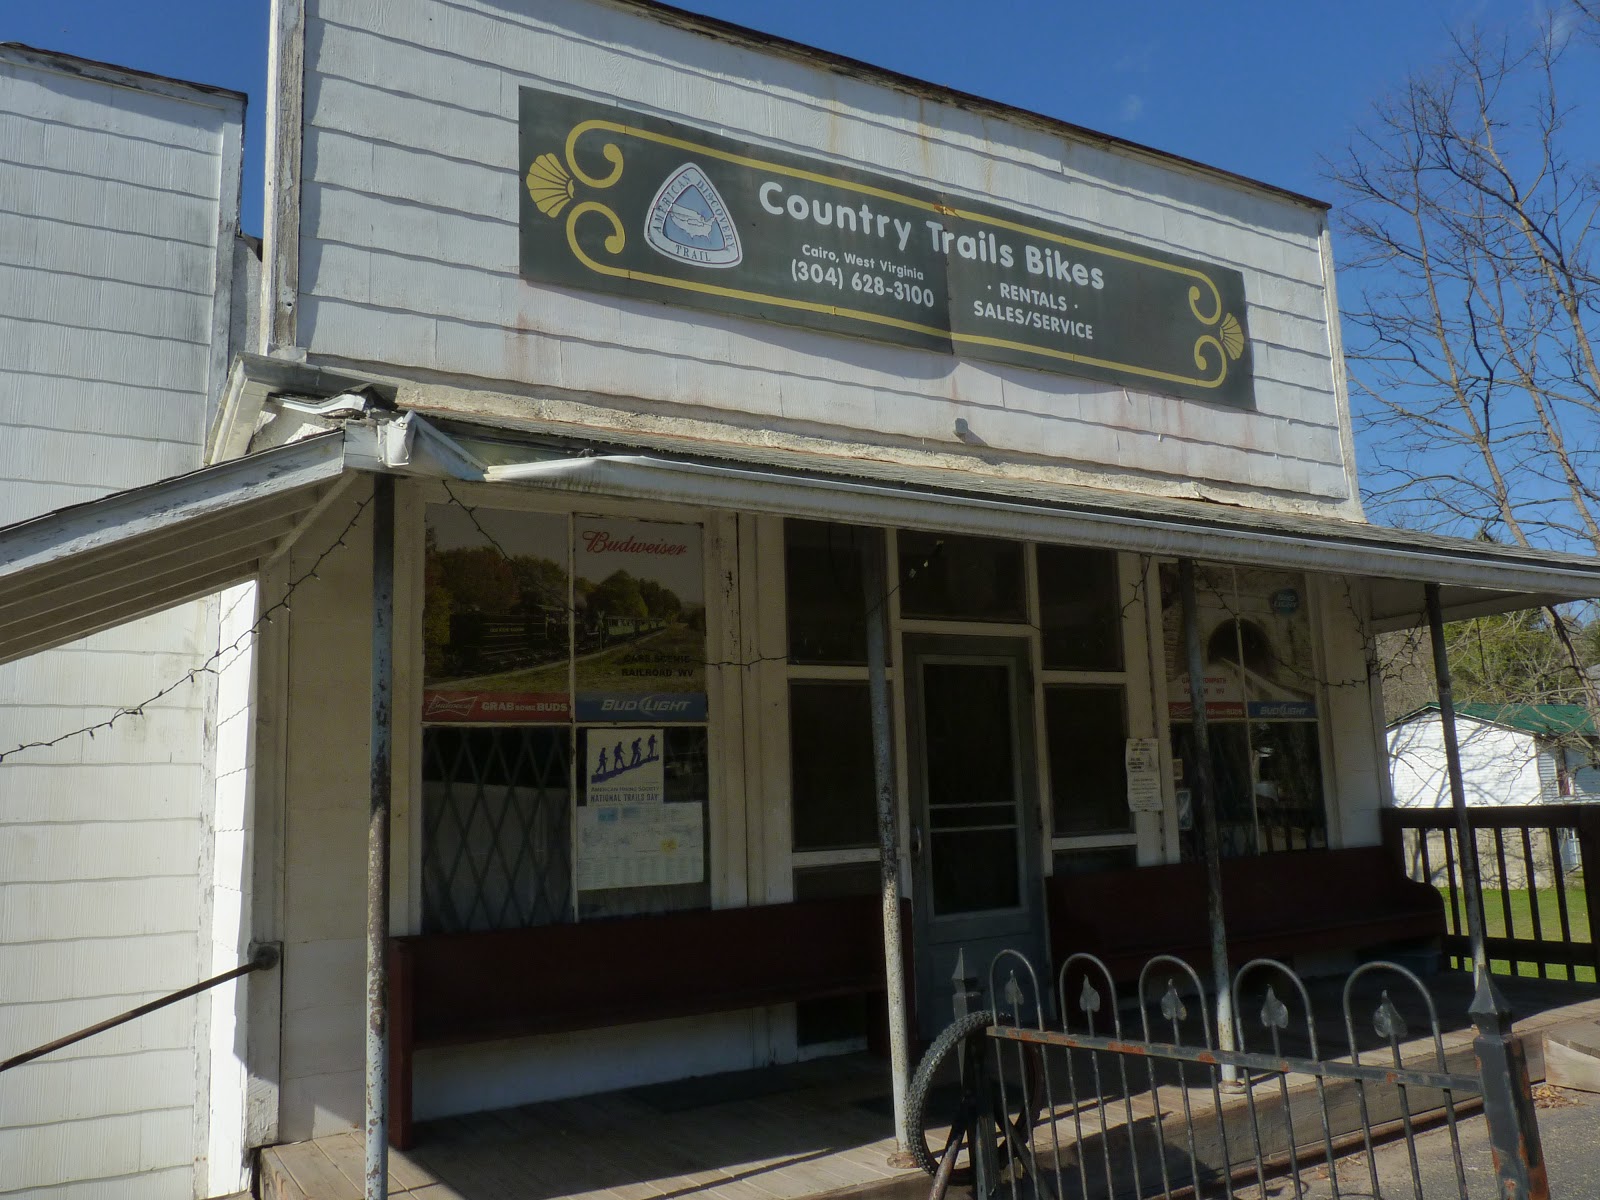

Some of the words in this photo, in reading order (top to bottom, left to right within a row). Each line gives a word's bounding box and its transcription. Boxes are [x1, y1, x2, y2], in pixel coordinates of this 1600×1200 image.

[652, 173, 691, 234] AMERICAN
[696, 179, 736, 249] DISCOVERY
[759, 181, 911, 251] Country
[925, 220, 1014, 268] Trails
[1025, 244, 1105, 290] Bikes
[675, 244, 711, 262] TRAIL
[801, 244, 840, 263] Cairo,
[844, 251, 875, 269] West
[879, 259, 924, 281] Virginia
[791, 258, 843, 290] (304)
[851, 272, 934, 308] 628-3100
[1000, 282, 1067, 312] RENTALS
[973, 300, 1093, 340] SALES/SERVICE
[582, 530, 688, 555] Budweiser
[621, 668, 672, 677] RAILROAD
[678, 668, 694, 677] WV
[481, 701, 514, 711] GRAB
[536, 702, 568, 712] BUDS
[601, 699, 638, 711] BUD
[644, 699, 692, 711] LIGHT
[1260, 706, 1280, 715] BUD
[591, 794, 621, 802] NATIONAL
[624, 793, 645, 801] TRAILS
